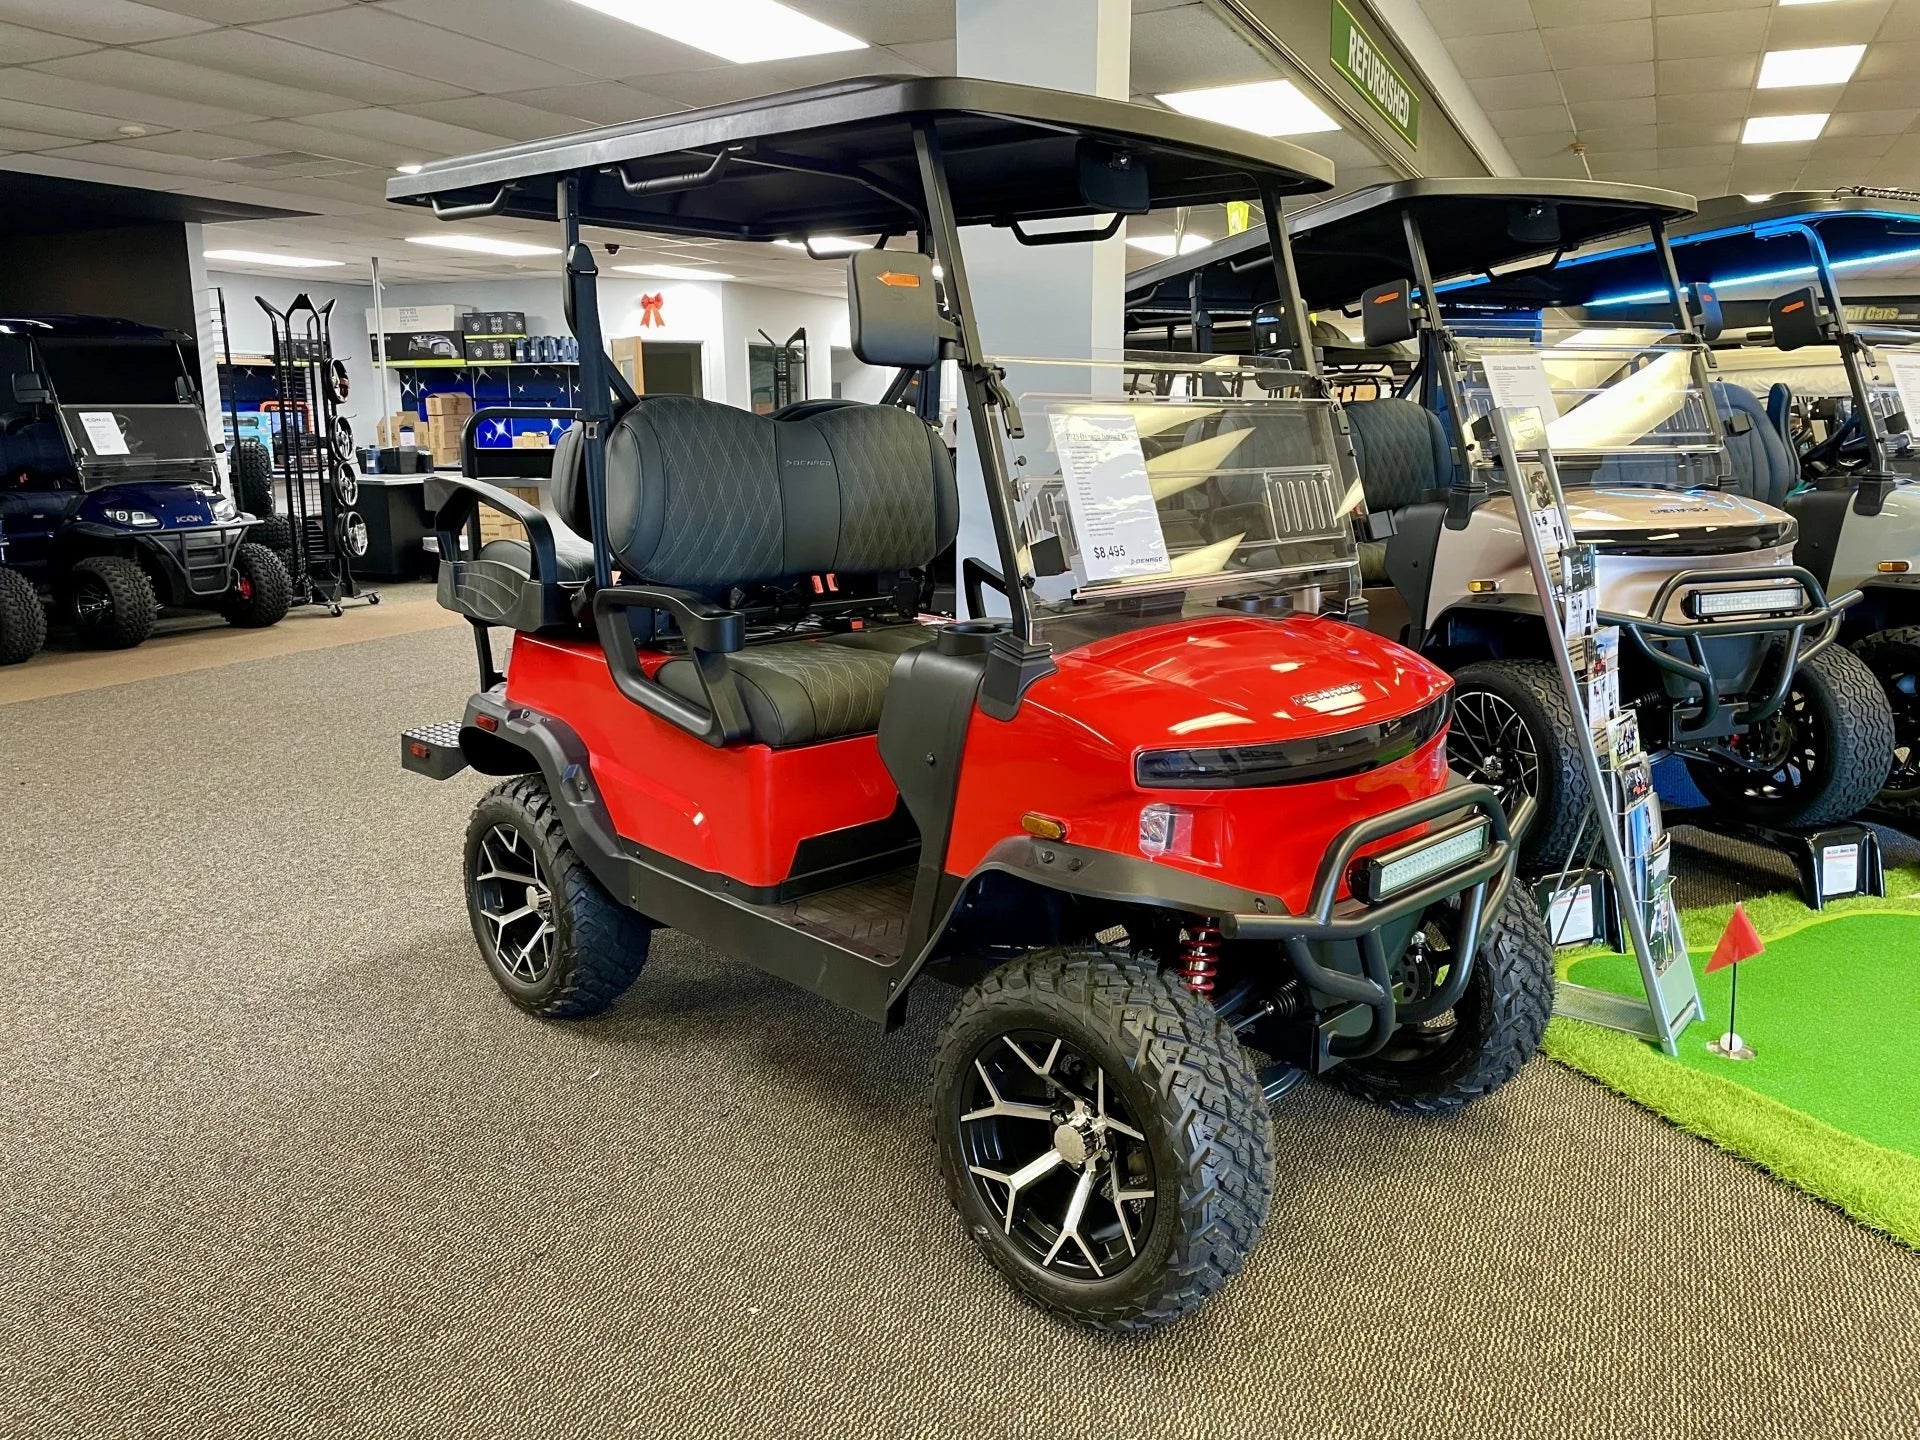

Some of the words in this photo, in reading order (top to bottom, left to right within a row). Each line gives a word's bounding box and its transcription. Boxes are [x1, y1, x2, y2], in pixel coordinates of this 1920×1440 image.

[1348, 25, 1410, 129] REFURBISHED
[1843, 305, 1866, 320] olf
[1866, 306, 1899, 320] Cars
[175, 514, 204, 524] ICON
[1093, 544, 1126, 561] $8,495
[1135, 556, 1164, 565] DENAGO
